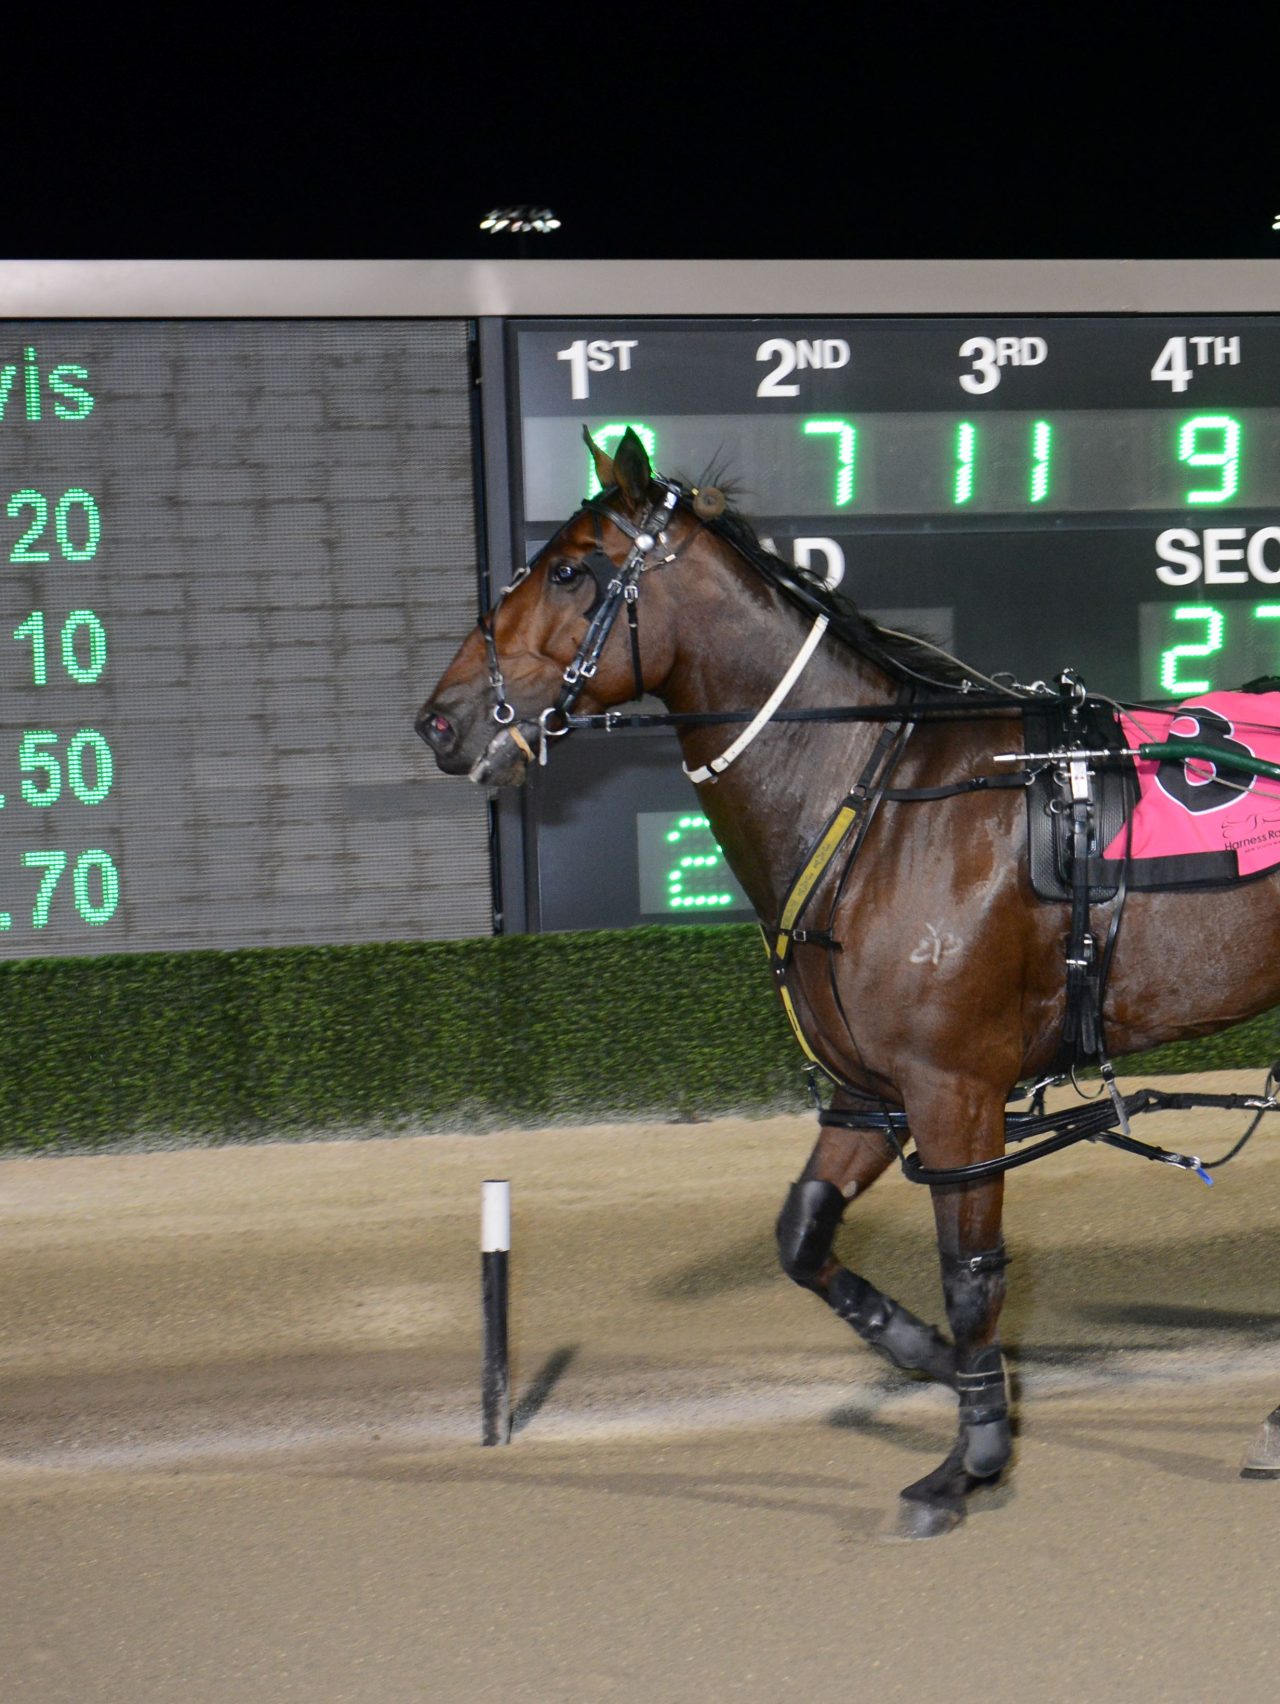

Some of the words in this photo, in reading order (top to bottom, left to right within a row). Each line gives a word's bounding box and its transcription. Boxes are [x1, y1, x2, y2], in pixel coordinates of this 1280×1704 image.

[557, 339, 639, 400] 1ST
[755, 338, 851, 398] 2ND
[958, 336, 1048, 395] 3RD
[1150, 336, 1241, 393] 4TH
[803, 418, 858, 506] 7
[1176, 413, 1243, 504] 9
[1154, 705, 1257, 816] 8
[1224, 834, 1267, 851] Harness
